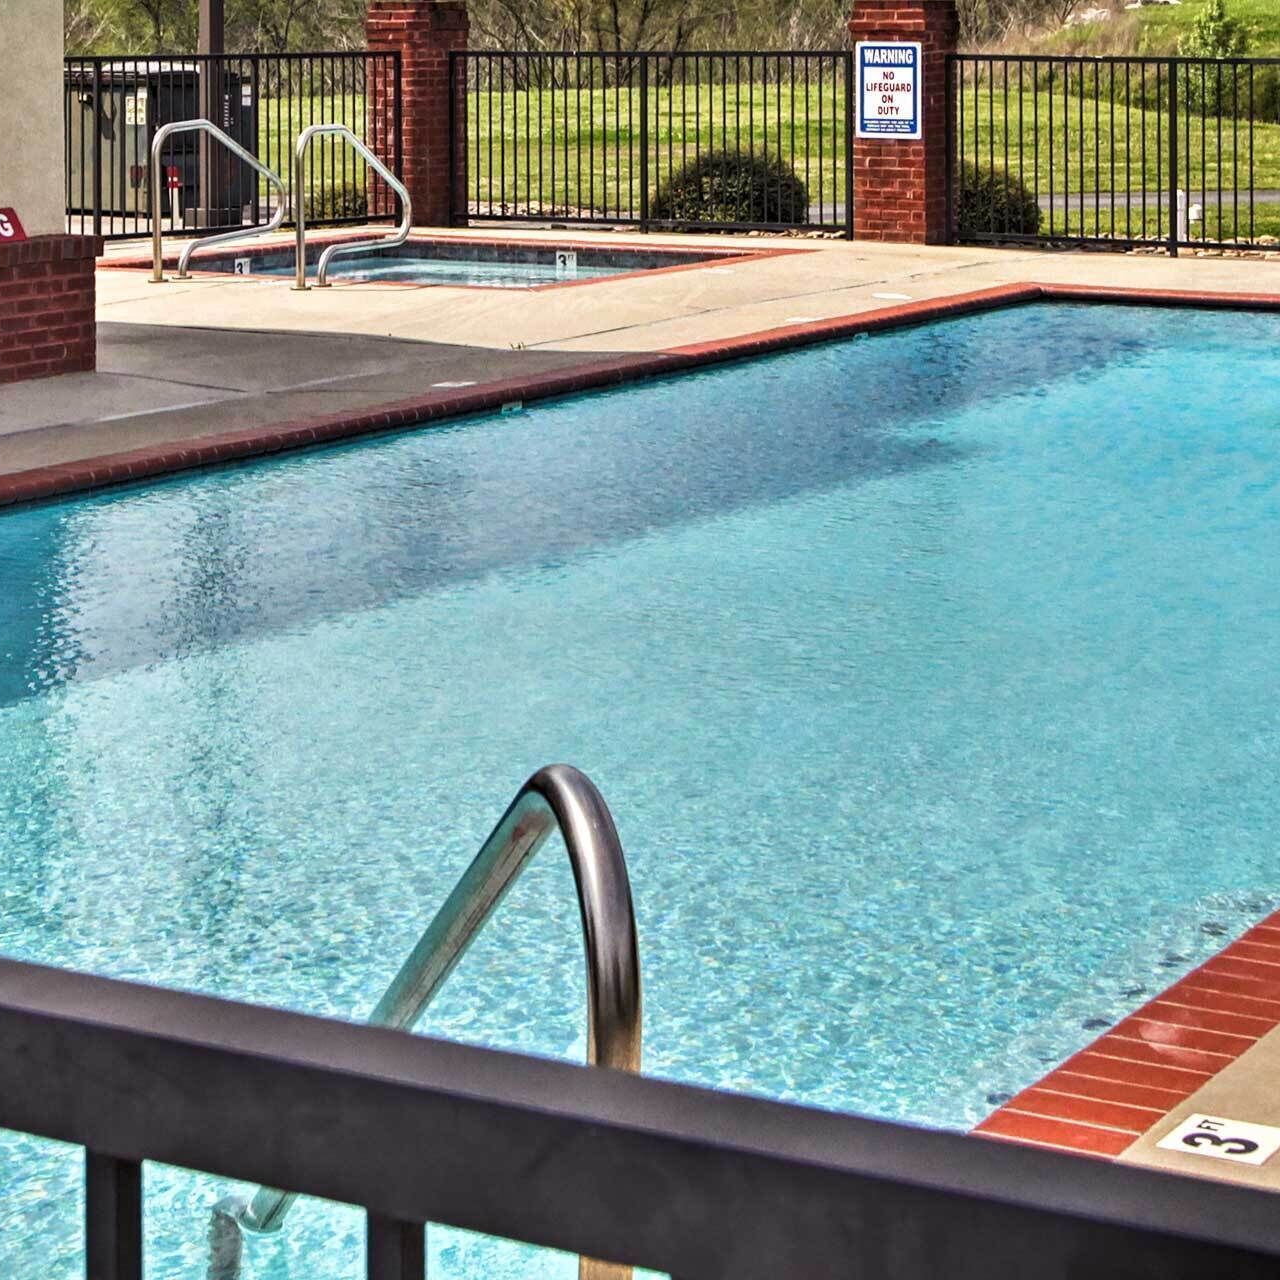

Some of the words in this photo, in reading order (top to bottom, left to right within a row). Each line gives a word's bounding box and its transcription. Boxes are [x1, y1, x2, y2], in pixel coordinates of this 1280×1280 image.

[863, 49, 914, 64] WARNING
[883, 71, 895, 80] NO
[866, 82, 912, 93] LIFEGUARD
[881, 94, 894, 104] ON
[877, 106, 900, 116] DUTY
[1197, 1119, 1225, 1132] FT
[1181, 1132, 1260, 1155] 3
